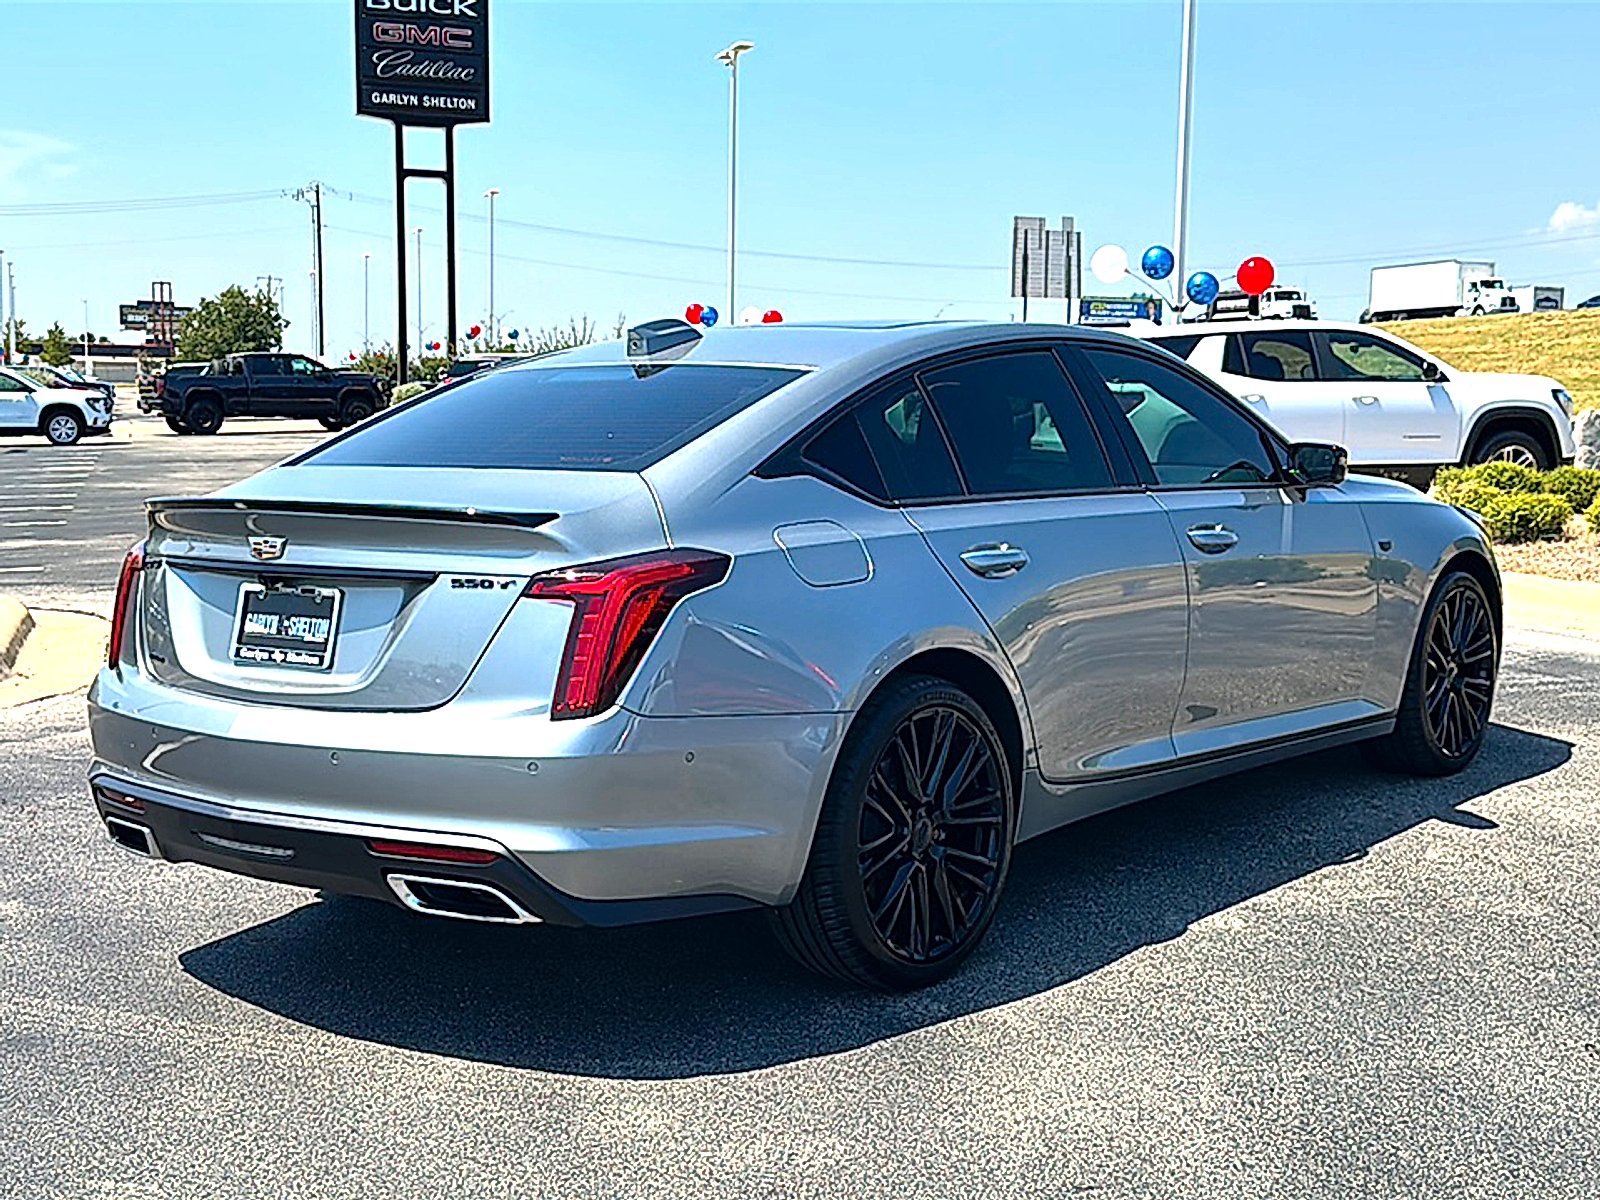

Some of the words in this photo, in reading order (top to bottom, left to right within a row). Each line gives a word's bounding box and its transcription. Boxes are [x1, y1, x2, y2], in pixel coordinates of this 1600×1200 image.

[372, 22, 473, 48] GMC
[372, 50, 475, 81] Cadillac
[371, 92, 418, 106] GARLYN
[422, 95, 476, 110] SHELTON
